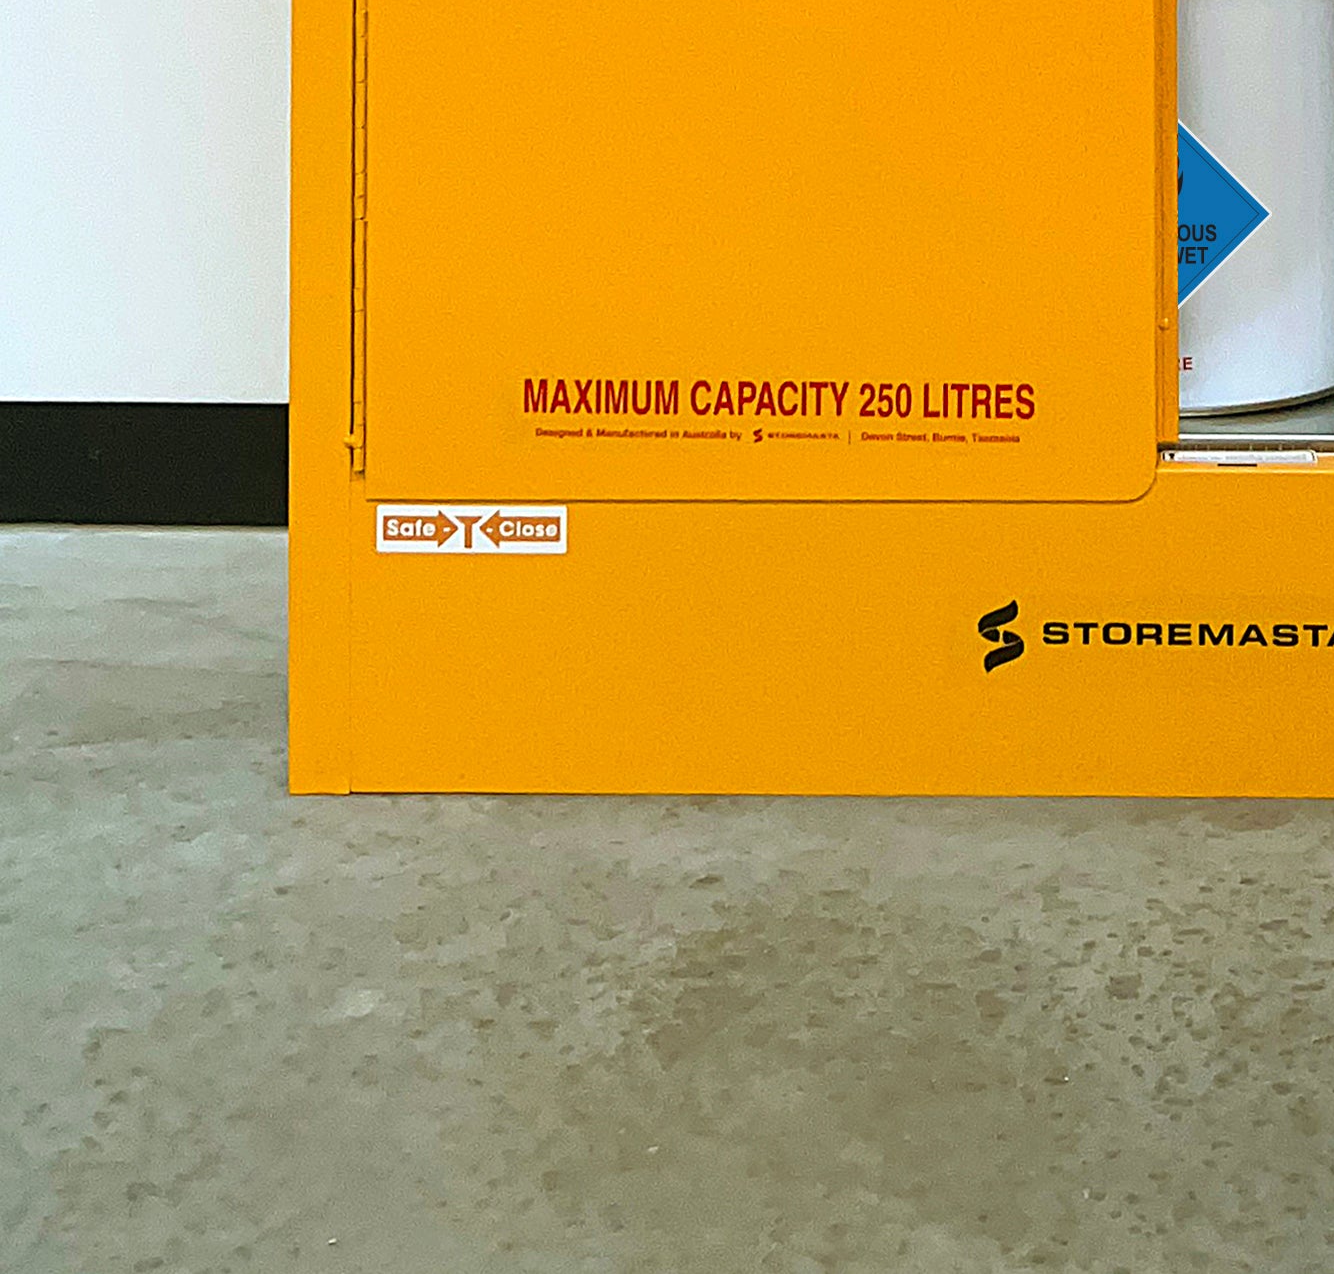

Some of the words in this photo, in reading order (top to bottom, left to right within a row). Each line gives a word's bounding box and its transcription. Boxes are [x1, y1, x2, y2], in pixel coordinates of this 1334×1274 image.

[523, 378, 679, 414] MAXIMUM
[690, 380, 850, 417] CAPACITY
[859, 383, 913, 418] 250
[923, 383, 1036, 420] LITRES
[535, 427, 584, 439] Designed
[596, 428, 668, 439] Manufactured
[682, 430, 727, 440] Australia
[729, 430, 743, 442] by
[454, 515, 484, 549] T
